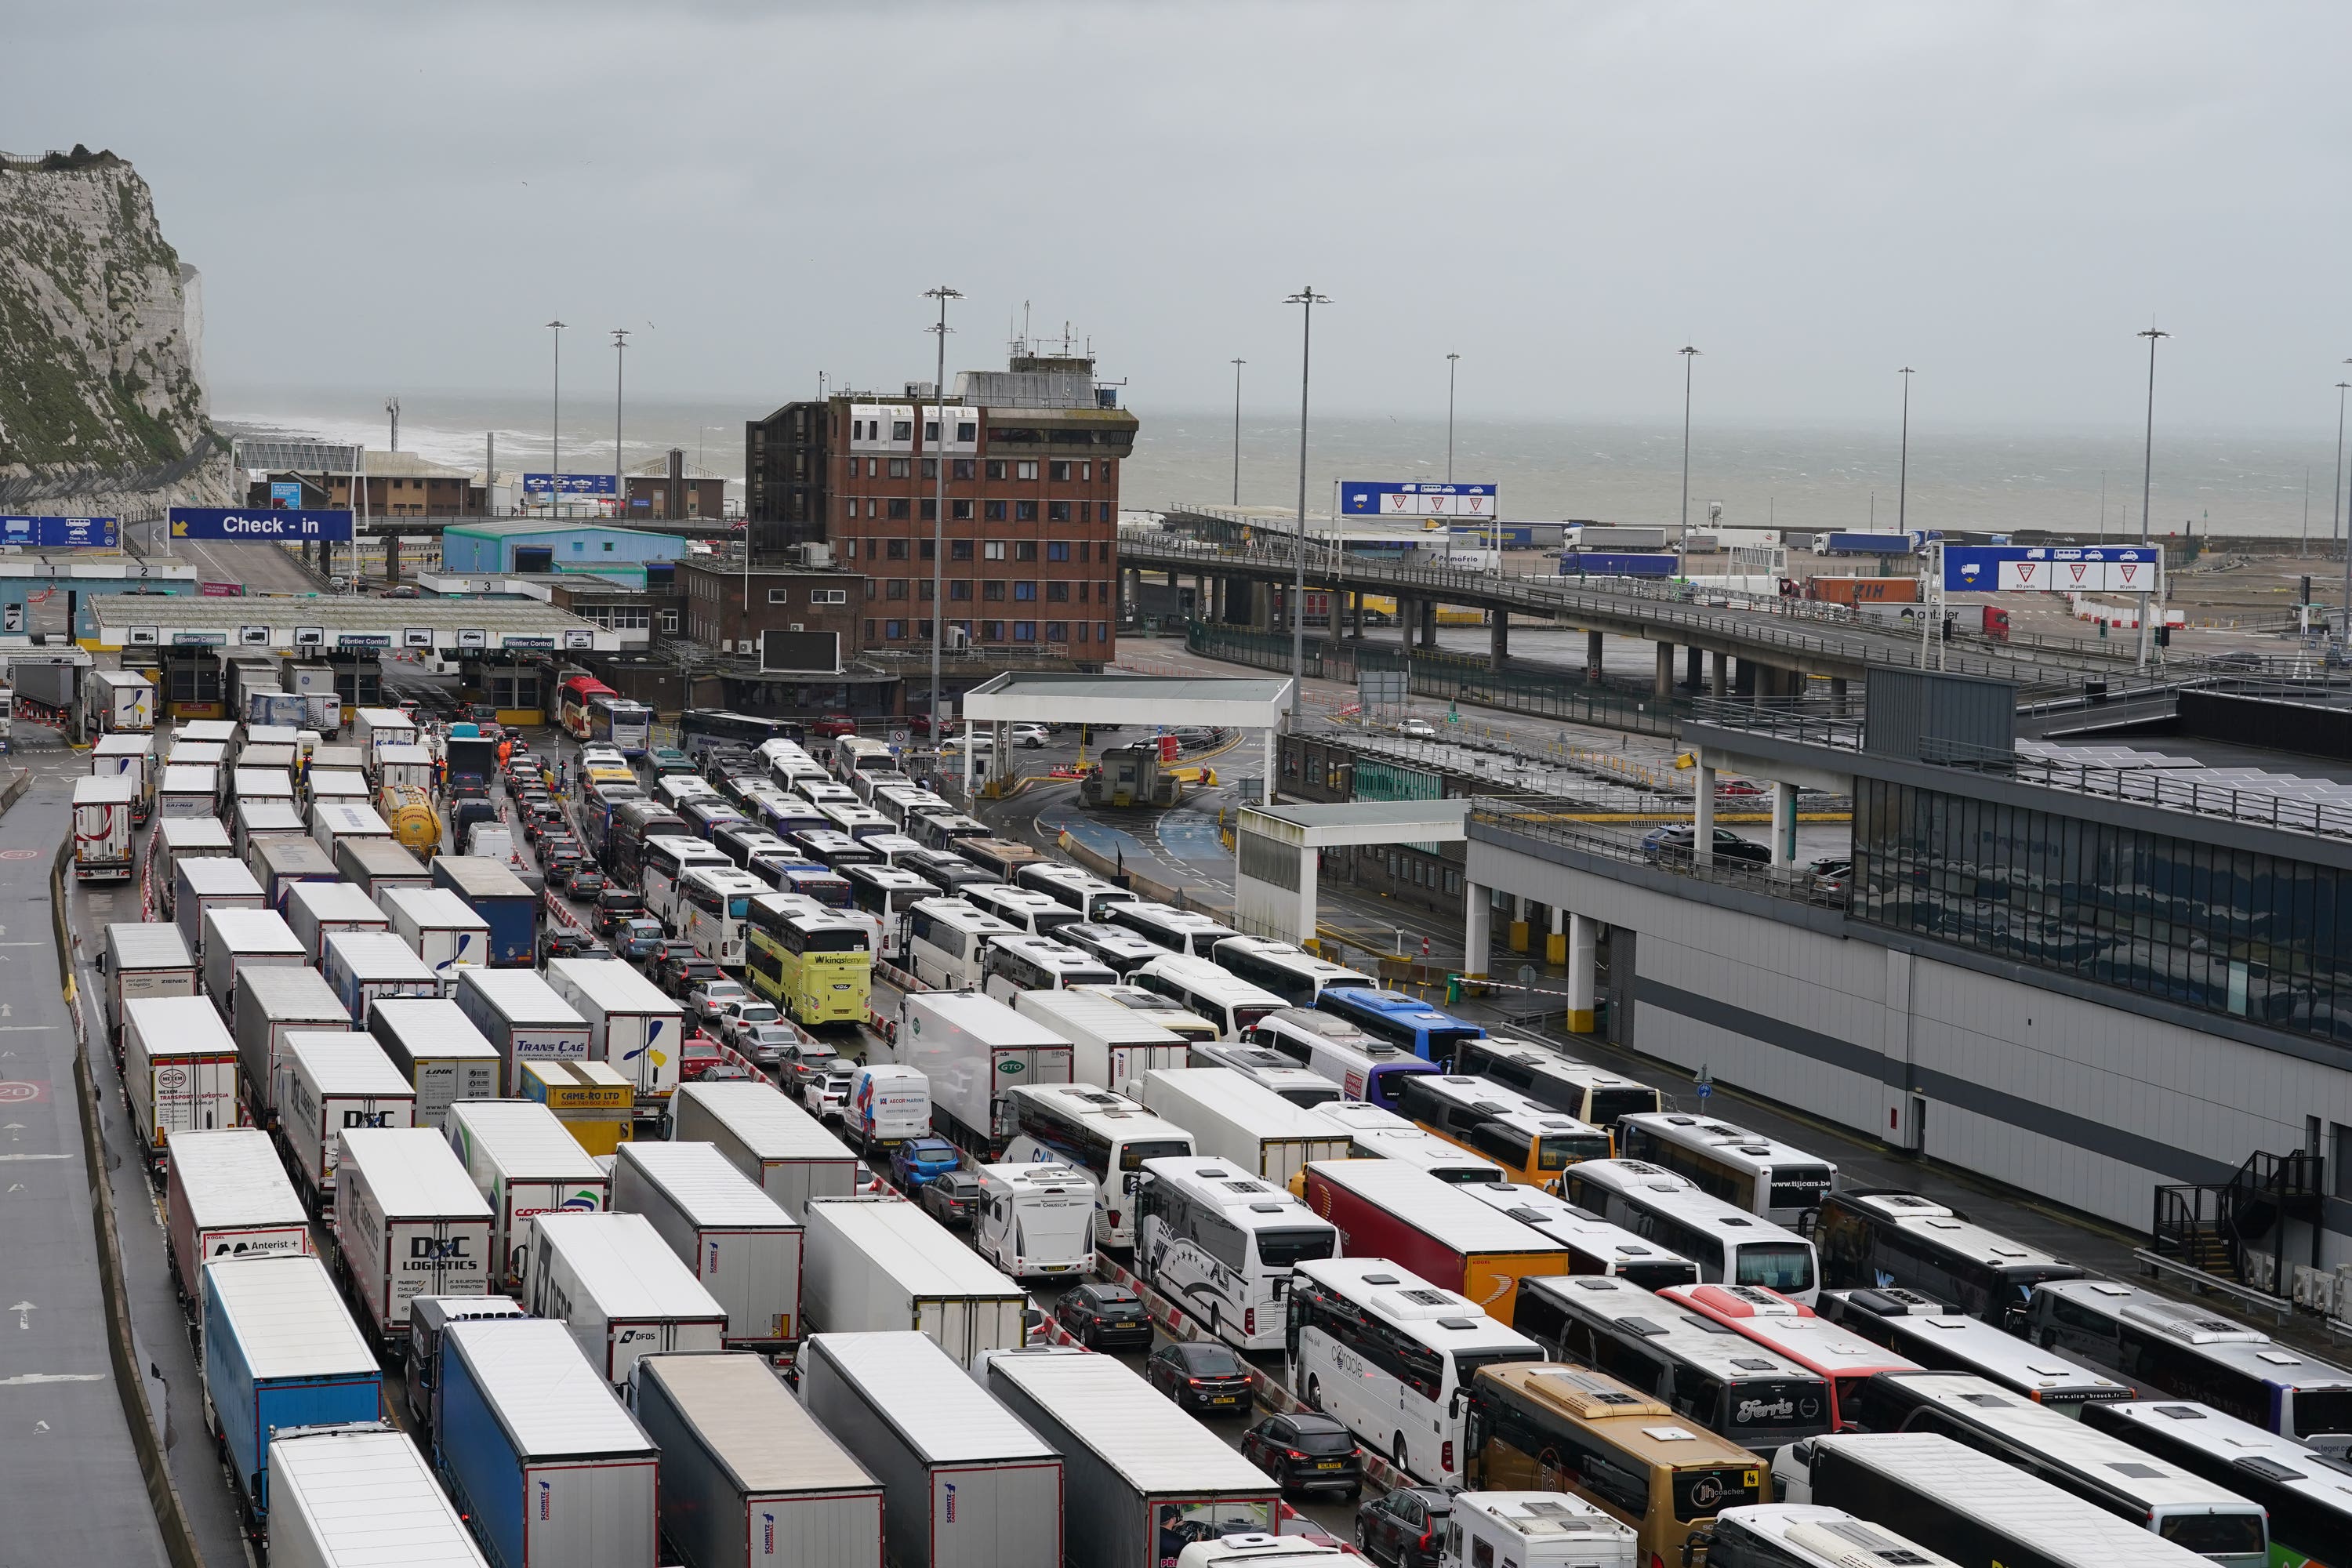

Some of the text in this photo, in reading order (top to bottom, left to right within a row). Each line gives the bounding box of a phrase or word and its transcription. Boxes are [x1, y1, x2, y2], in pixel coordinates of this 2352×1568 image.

[223, 516, 283, 532] Check
[302, 518, 319, 533] in
[50, 566, 55, 575] 1
[141, 567, 148, 577] 2
[825, 955, 861, 964] kingsferry
[252, 1240, 288, 1250] Anterist
[403, 1261, 477, 1271] LOGISTICS
[1332, 1345, 1362, 1378] coracle
[1737, 1398, 1794, 1423] Ferris
[1700, 1485, 1714, 1501] jh
